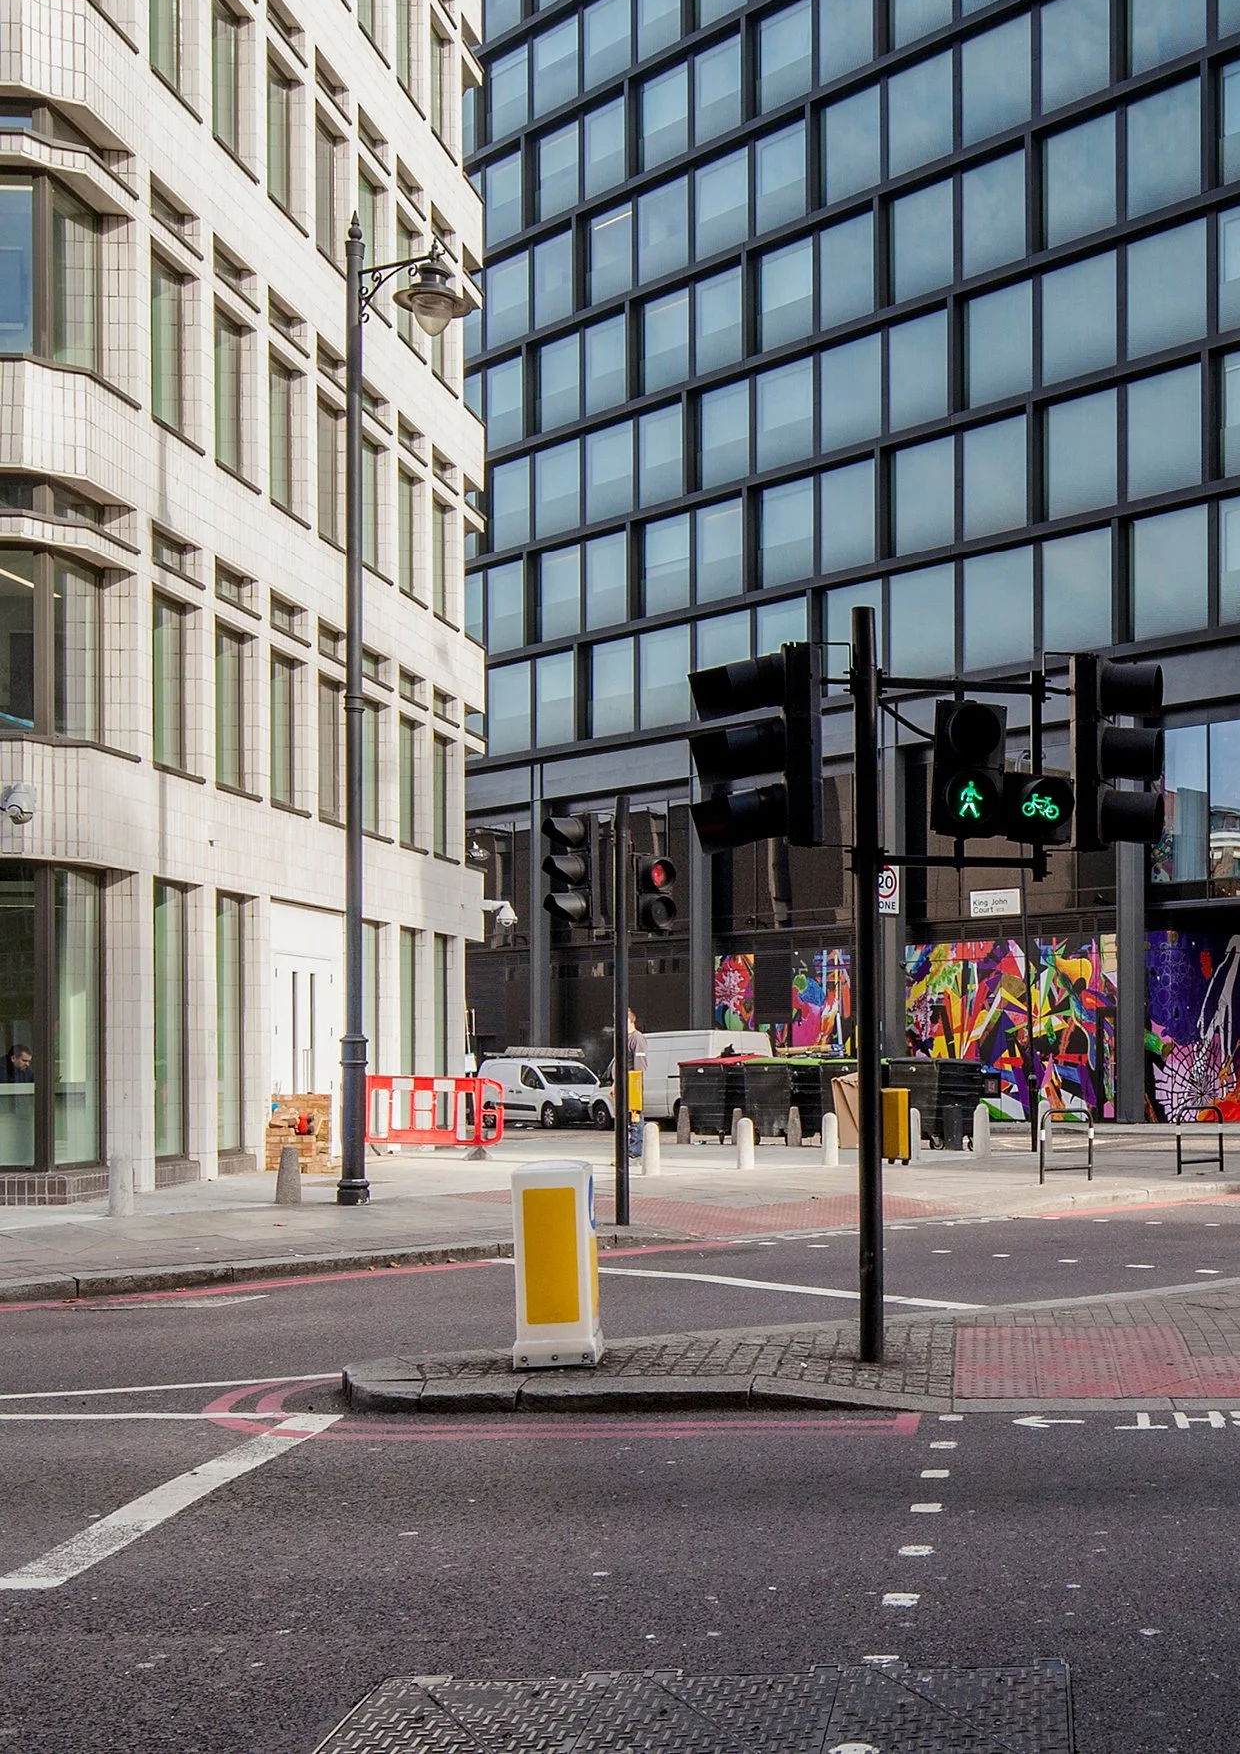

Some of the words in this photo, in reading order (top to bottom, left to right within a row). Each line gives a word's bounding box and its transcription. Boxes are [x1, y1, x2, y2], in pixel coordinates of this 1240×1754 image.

[878, 875, 894, 889] 20
[878, 901, 897, 910] ONE
[973, 898, 989, 908] King
[991, 897, 1008, 906] John
[972, 906, 994, 914] Court
